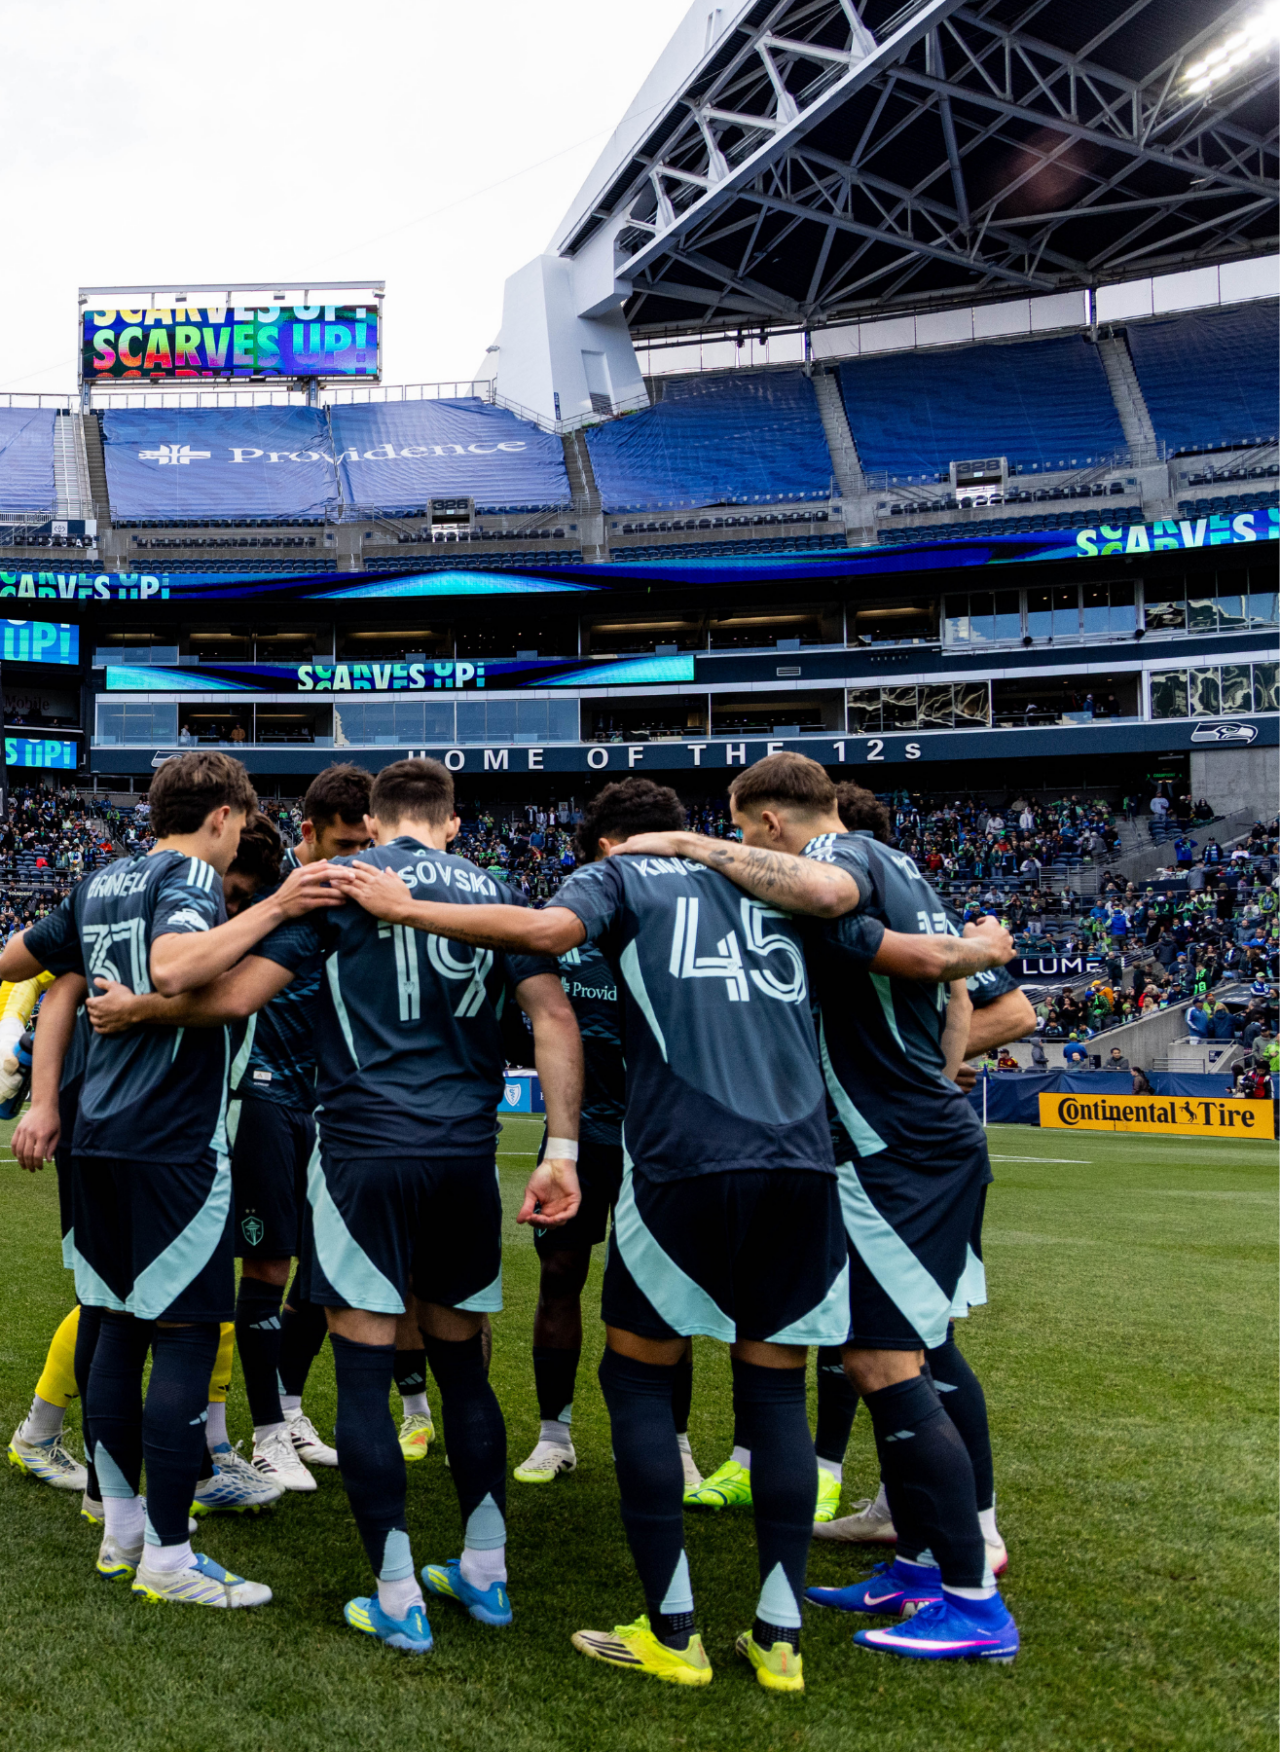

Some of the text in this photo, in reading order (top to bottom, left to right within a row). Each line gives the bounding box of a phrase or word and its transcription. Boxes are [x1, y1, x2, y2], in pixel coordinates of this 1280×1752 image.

[92, 322, 368, 370] SCARVES UP!
[228, 440, 529, 465] Providence
[586, 746, 644, 770] OF
[832, 740, 922, 763] 12s
[397, 861, 497, 897] SOVSKI
[631, 857, 708, 877] KING
[82, 916, 154, 996] 37
[669, 896, 807, 1005] 45
[1022, 956, 1103, 975] LUME
[376, 919, 494, 1022] 19
[571, 981, 618, 1002] Provid
[1057, 1097, 1256, 1128] Continental Tire
